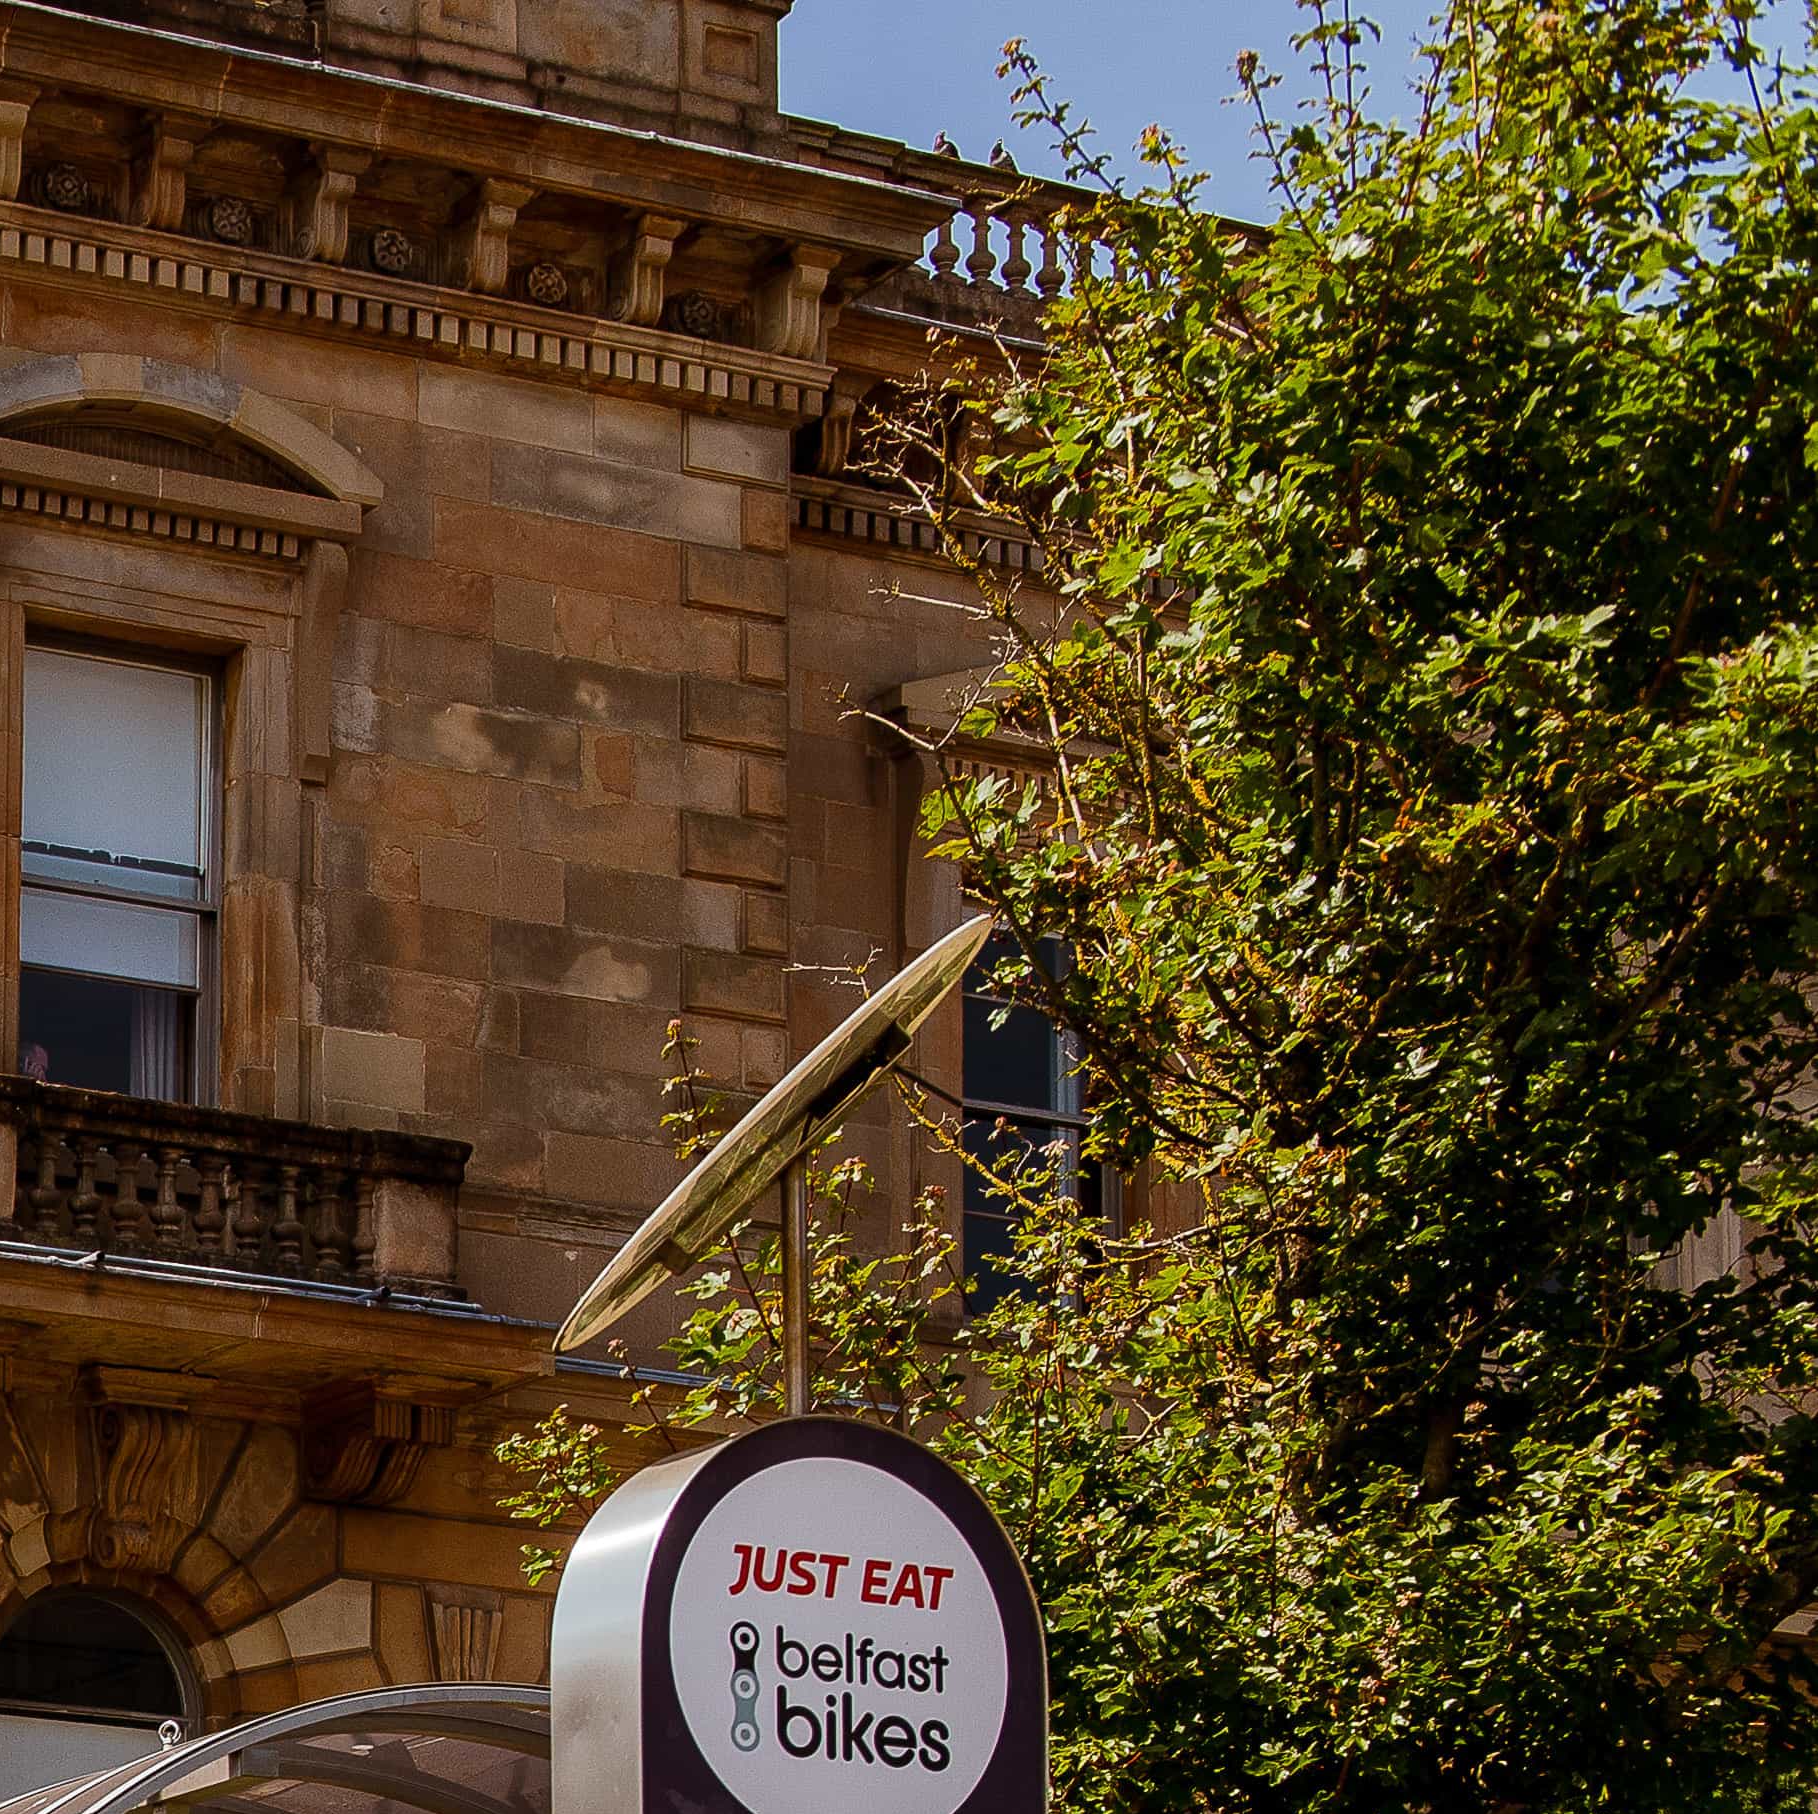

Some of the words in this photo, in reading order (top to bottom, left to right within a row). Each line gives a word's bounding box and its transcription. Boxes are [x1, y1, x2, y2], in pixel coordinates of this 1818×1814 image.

[729, 1544, 849, 1598] JUST
[861, 1559, 954, 1611] EAT
[775, 1625, 950, 1693] belfast
[776, 1685, 951, 1772] bikes
